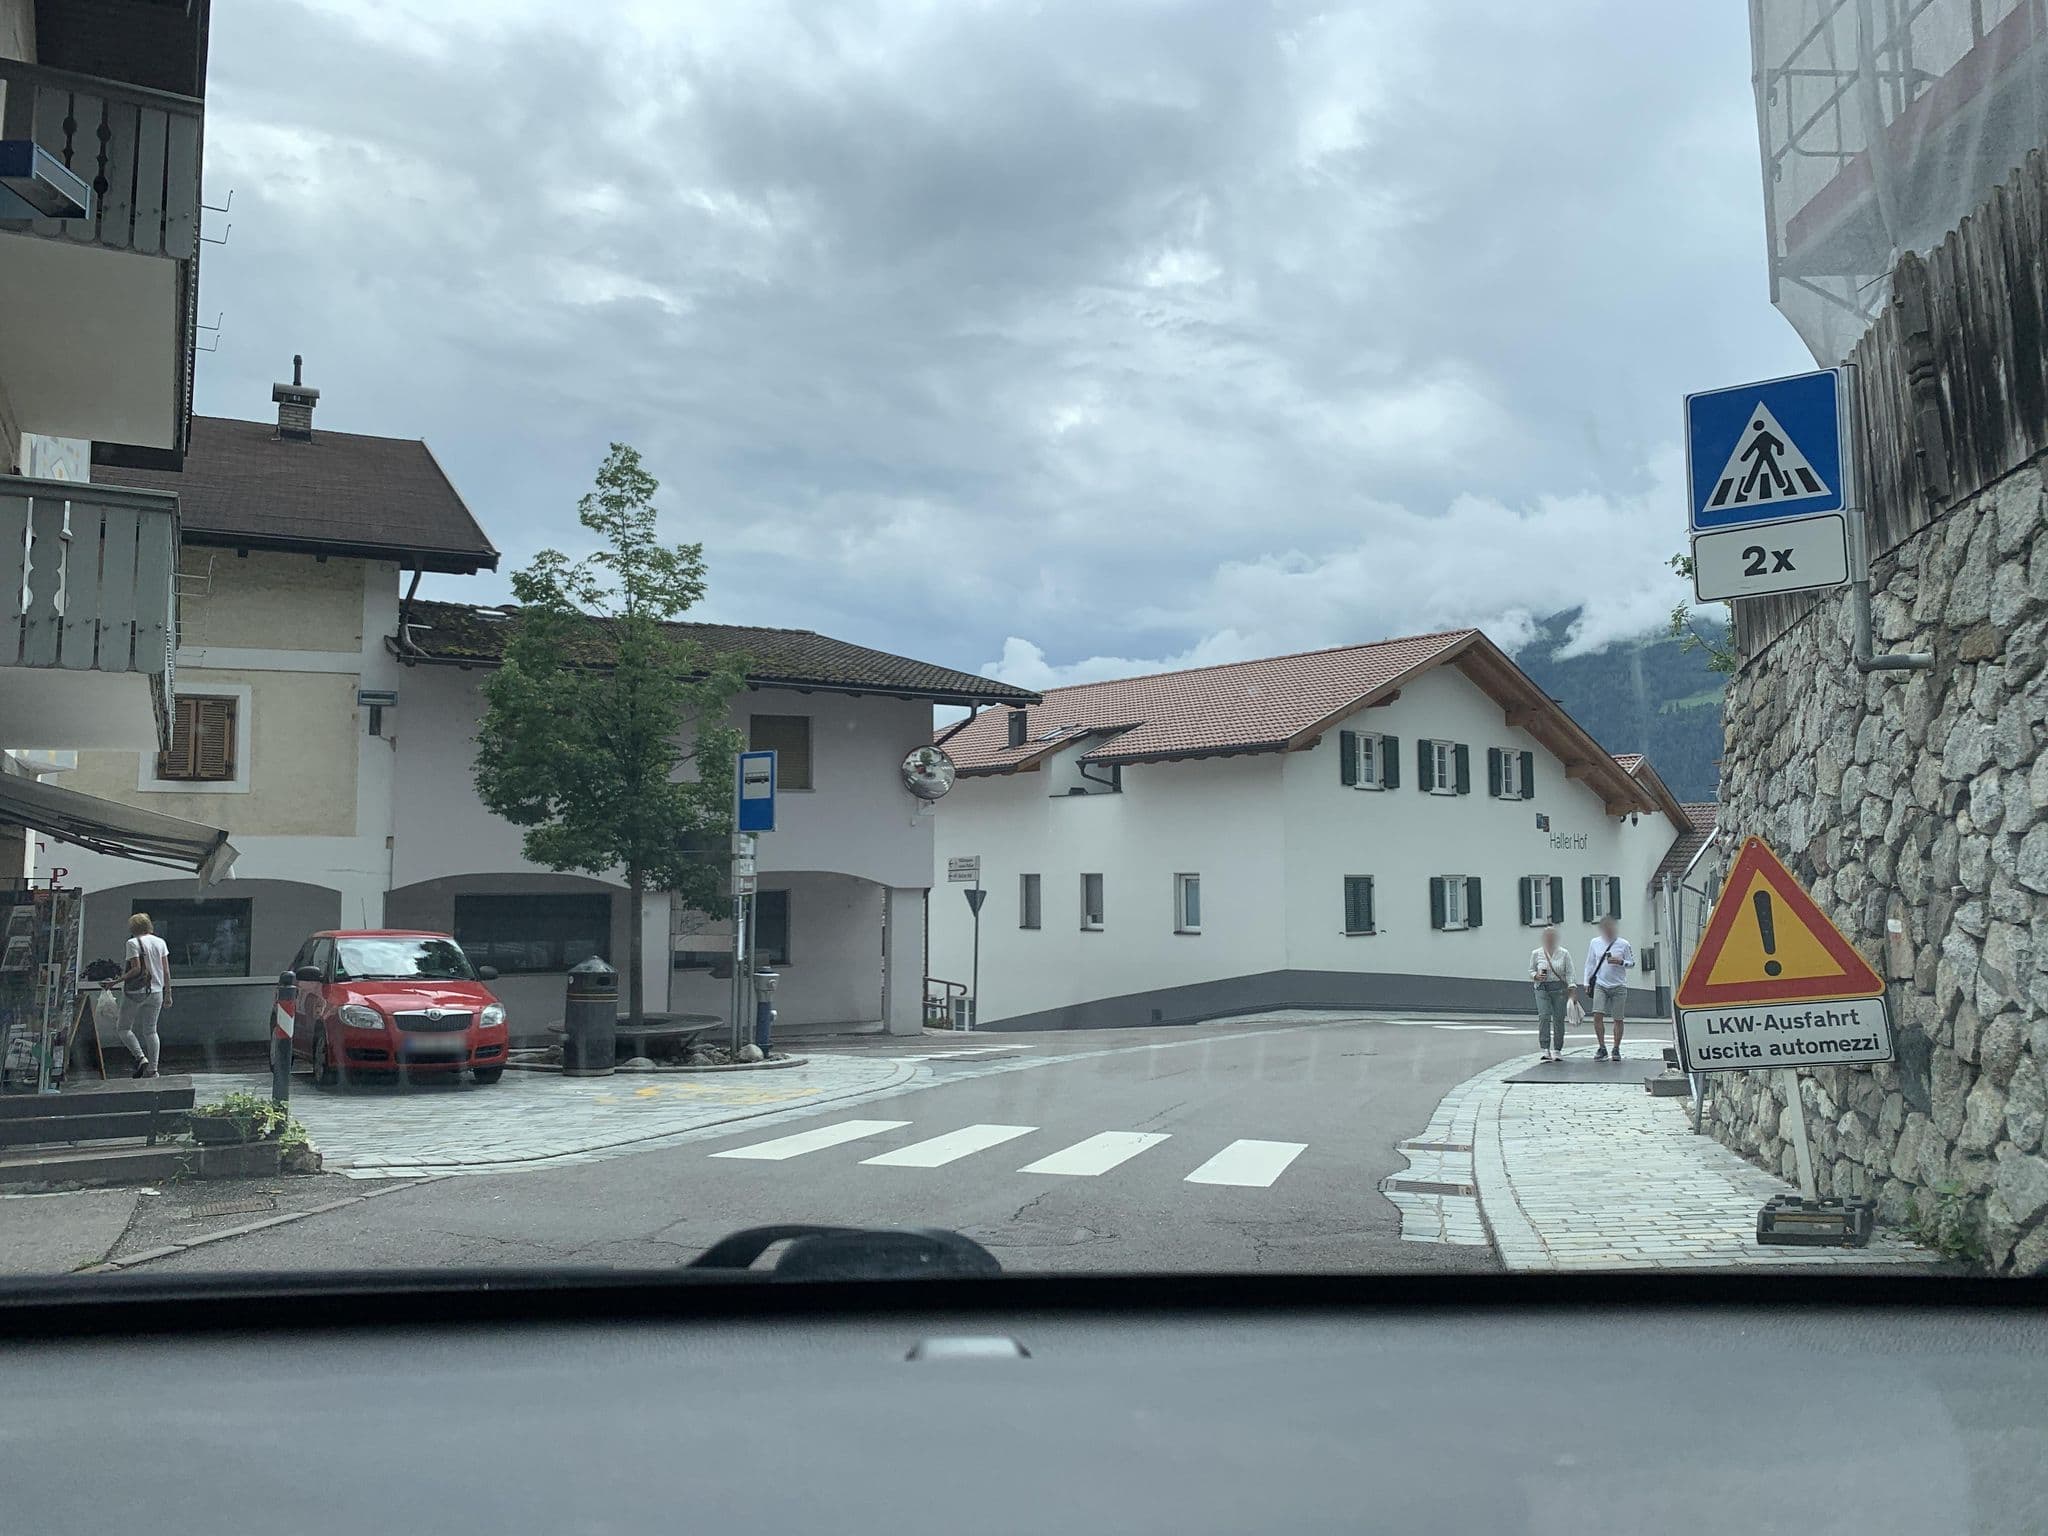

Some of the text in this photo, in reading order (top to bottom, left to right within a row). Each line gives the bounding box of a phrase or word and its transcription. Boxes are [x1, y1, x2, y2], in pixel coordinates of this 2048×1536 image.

[1742, 545, 1796, 577] 2x
[1550, 832, 1588, 850] Haller Hof
[1707, 1009, 1860, 1035] LKW-Ausfahrt
[1699, 1033, 1880, 1061] uscita automezzi
